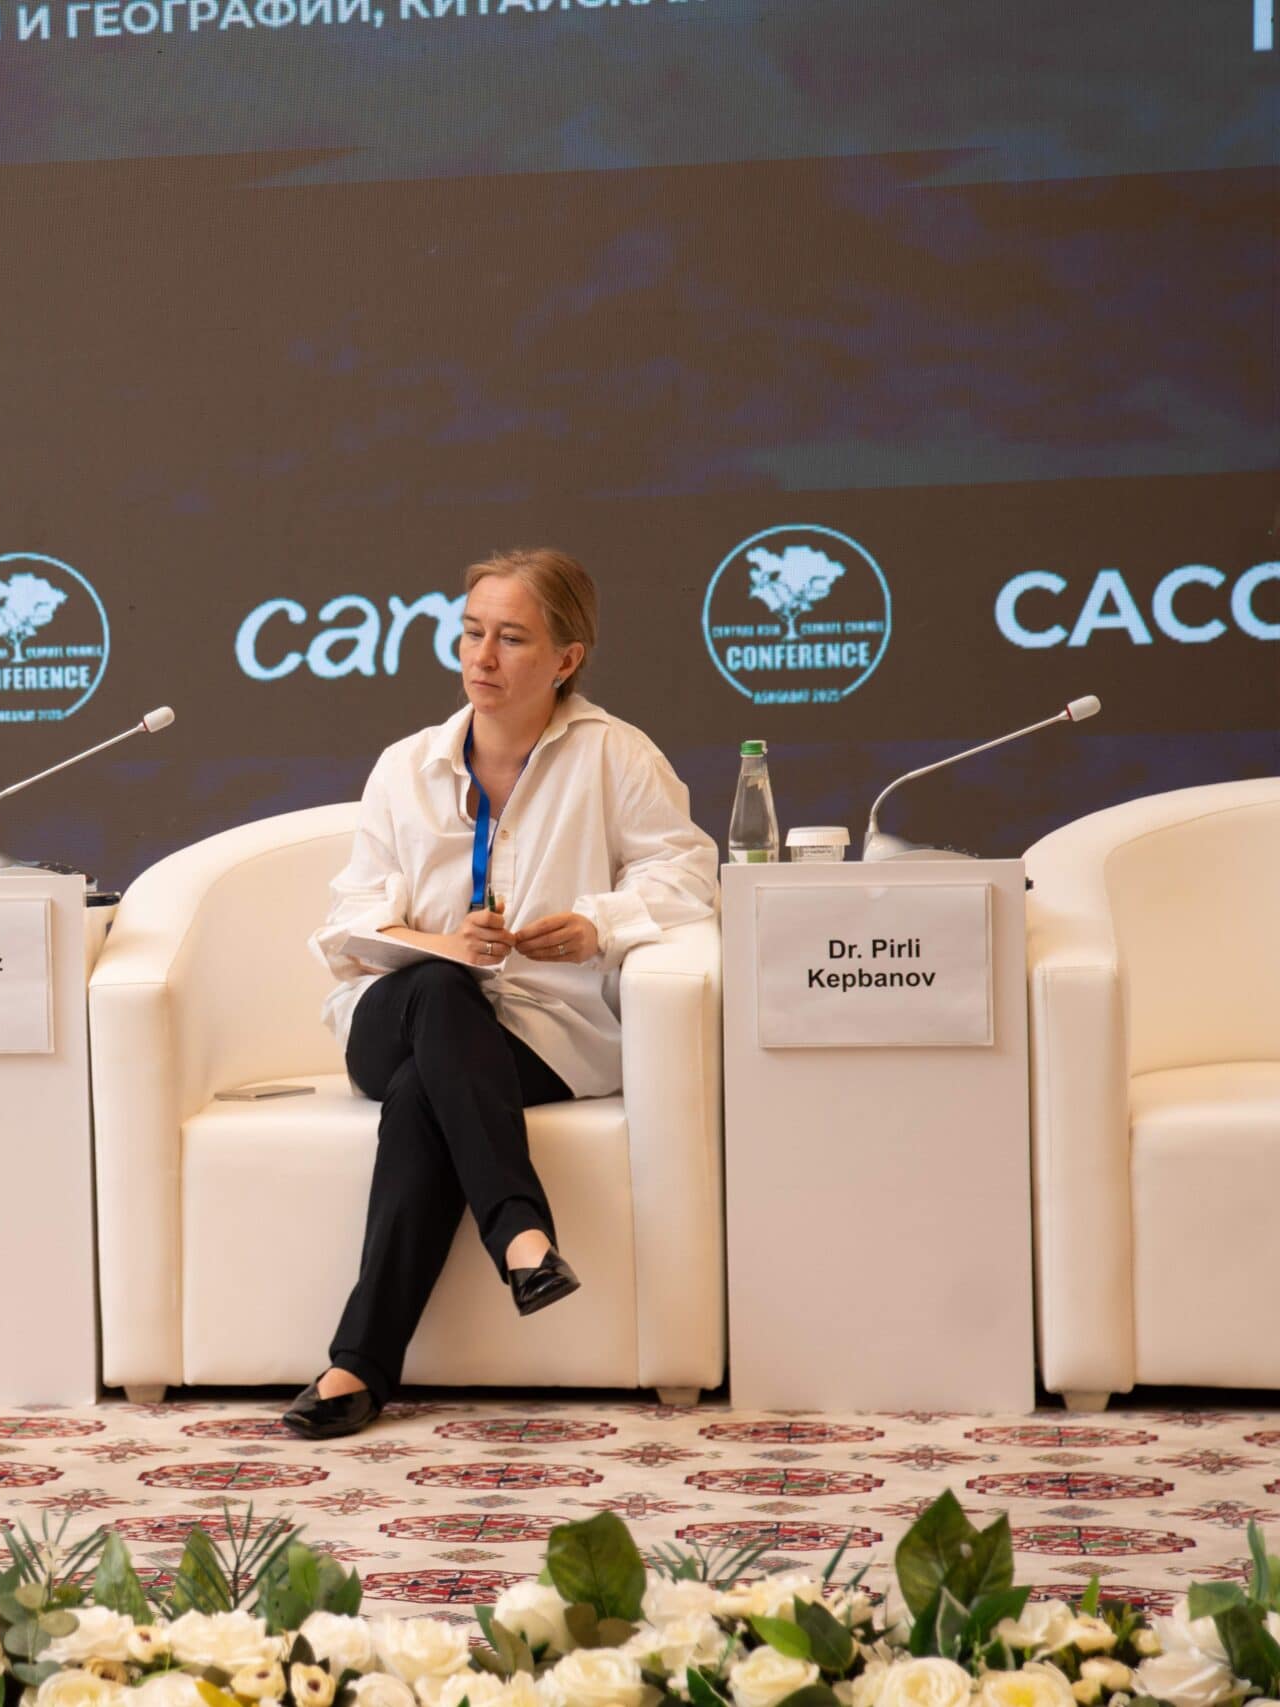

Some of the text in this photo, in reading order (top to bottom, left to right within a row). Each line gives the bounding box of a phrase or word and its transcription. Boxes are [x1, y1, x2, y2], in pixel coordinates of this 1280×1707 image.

[17, 4, 51, 41] И
[66, 0, 384, 38] ГЕОГРАФИИ,
[726, 642, 870, 671] CONFERENCE
[828, 938, 921, 959] Dr. Pirli
[808, 968, 936, 992] Kepbanov
